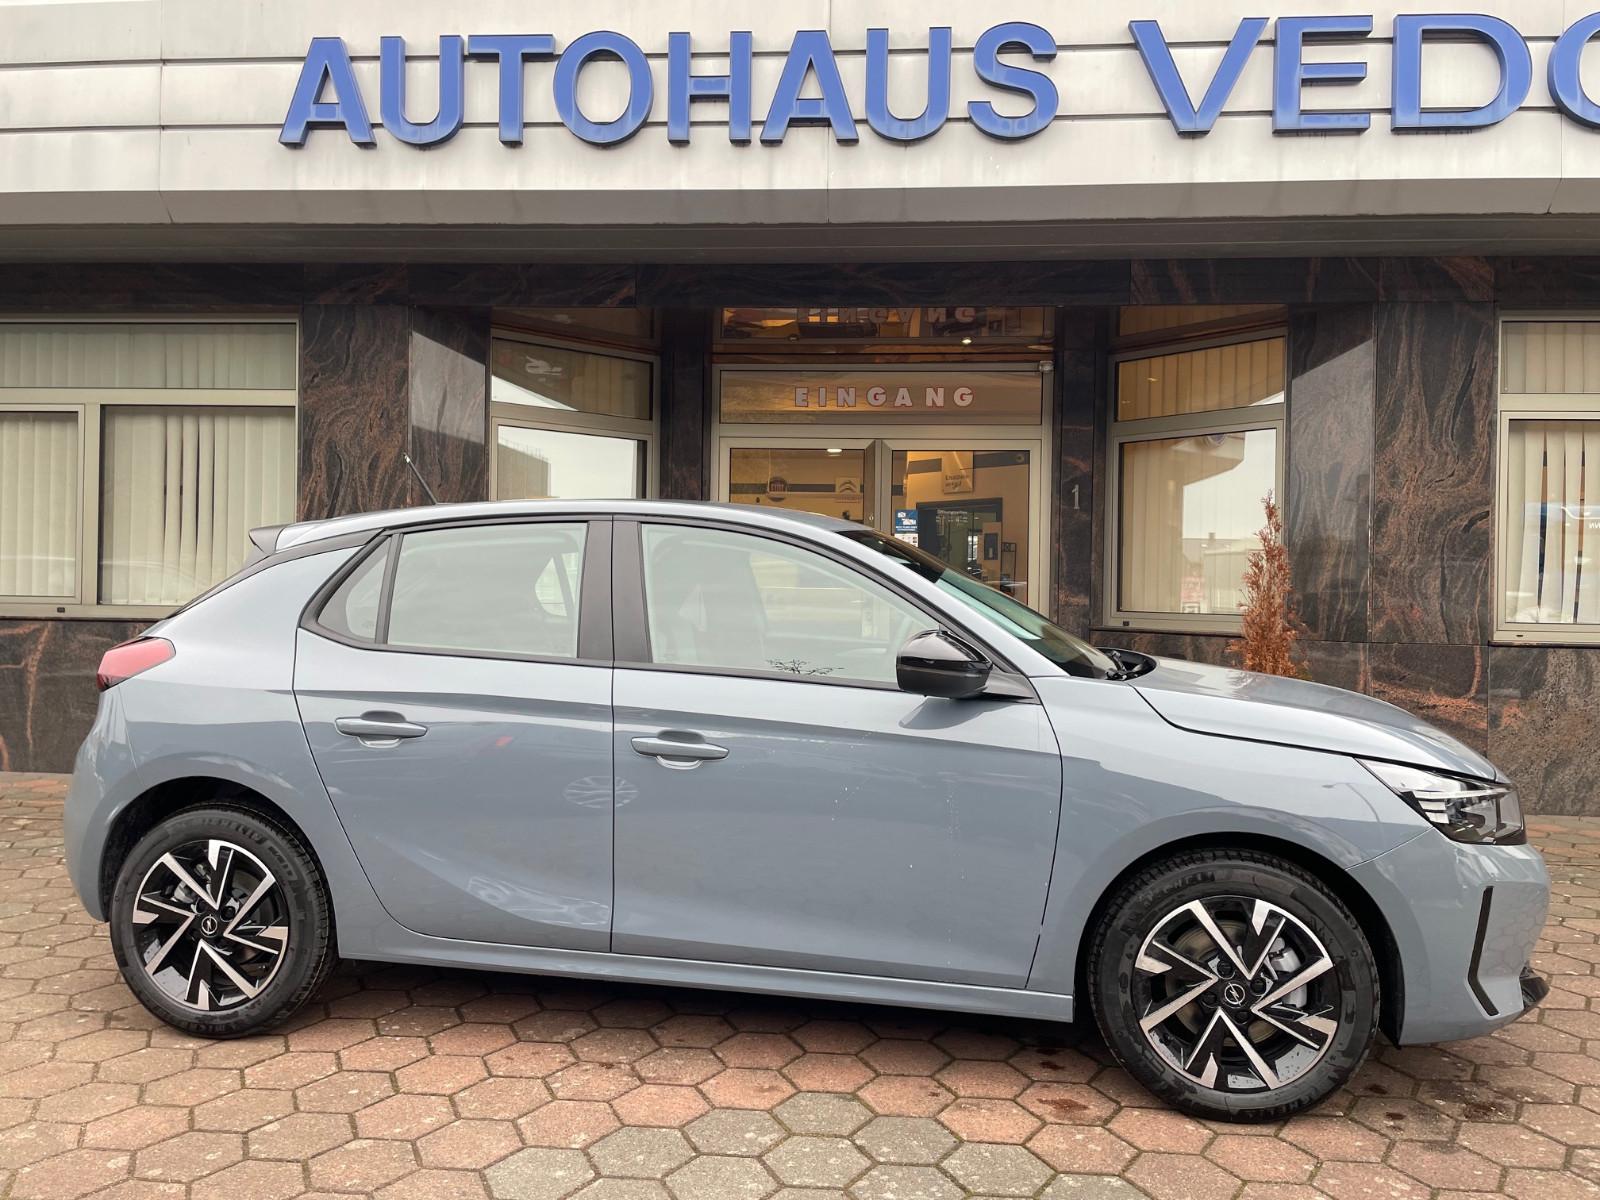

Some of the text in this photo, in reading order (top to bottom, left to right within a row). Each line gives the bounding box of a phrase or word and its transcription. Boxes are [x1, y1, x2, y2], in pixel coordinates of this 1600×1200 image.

[279, 22, 1059, 148] AUTOHAUS
[795, 386, 974, 408] EINGANG
[1071, 484, 1080, 510] 1
